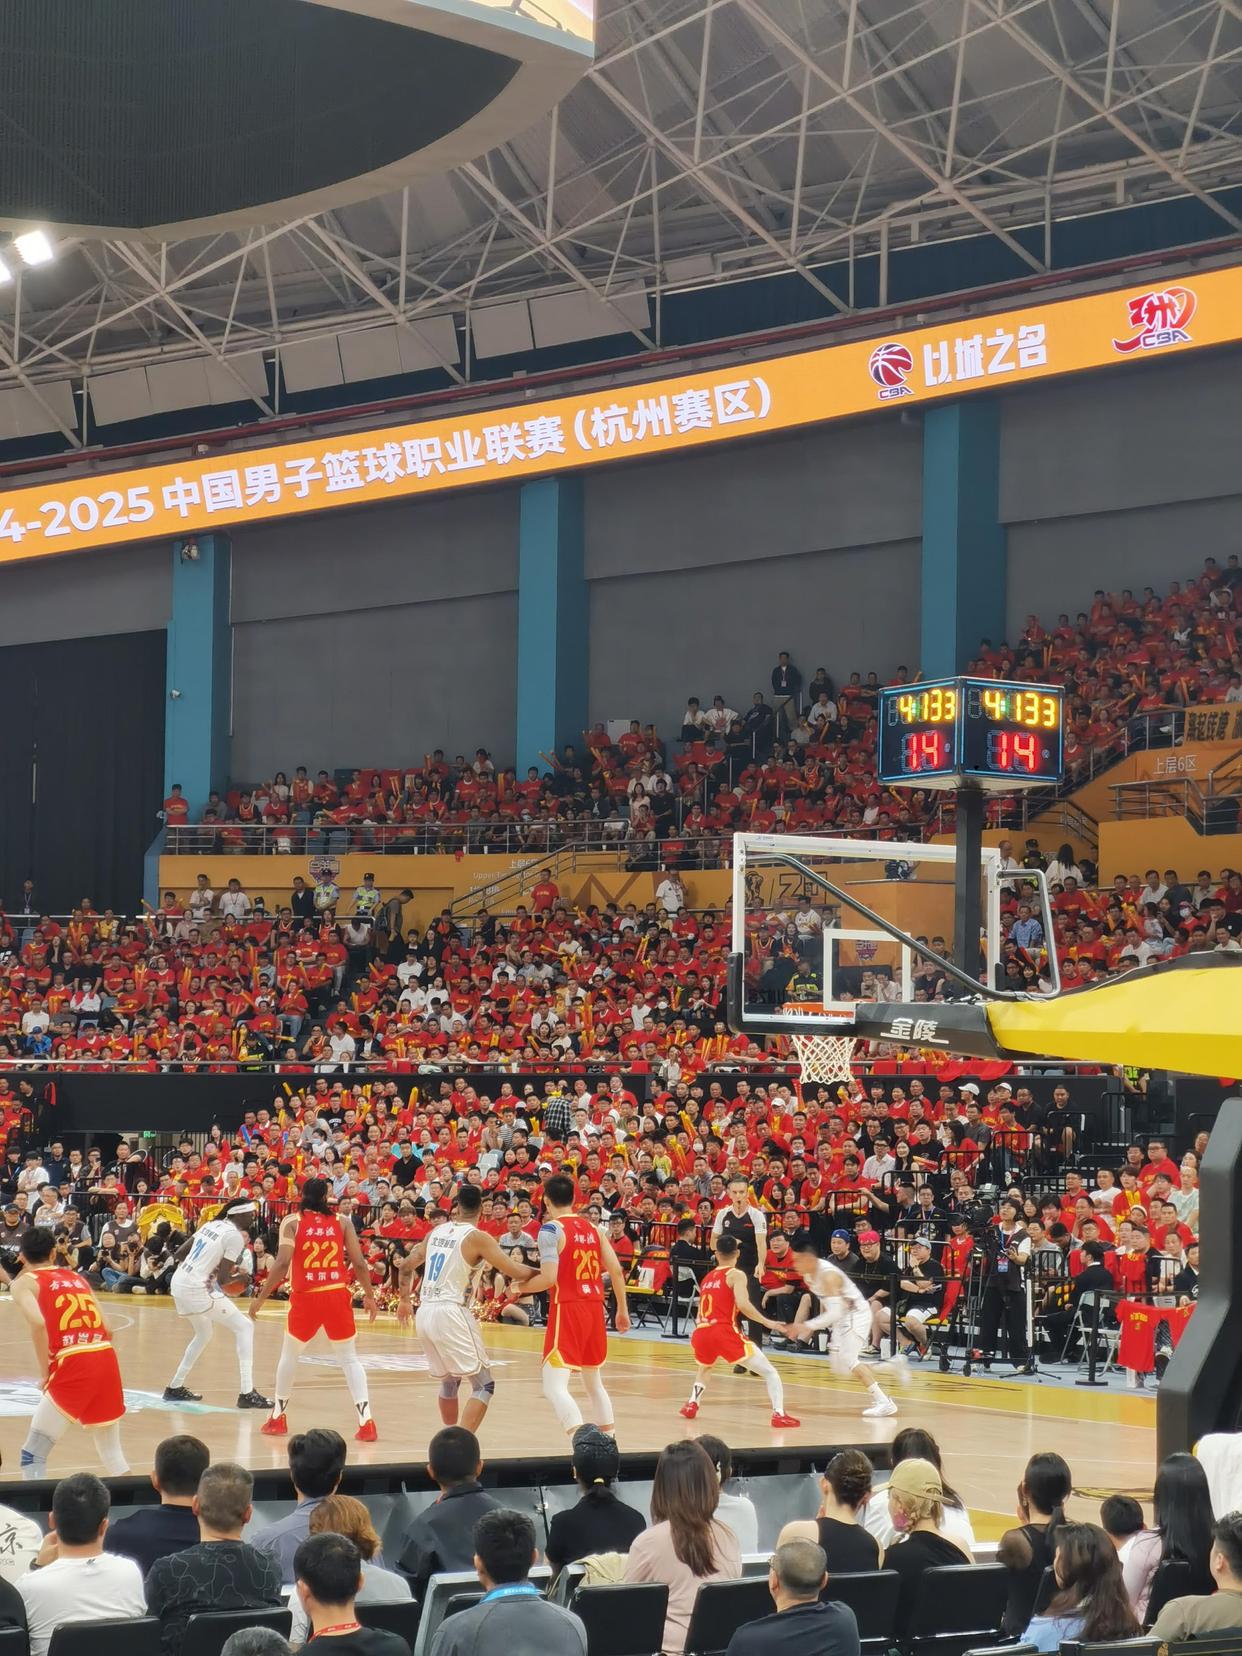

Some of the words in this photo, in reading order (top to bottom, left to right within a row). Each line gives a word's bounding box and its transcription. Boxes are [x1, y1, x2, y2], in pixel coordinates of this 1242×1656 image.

[1142, 330, 1190, 348] CBA
[923, 324, 1048, 387] 以城之名
[879, 387, 915, 399] CBA
[911, 733, 939, 769] 14
[1001, 733, 1036, 770] 14
[1153, 754, 1200, 774] 上层6区
[880, 1017, 949, 1044] 金陵
[302, 1241, 339, 1269] 22
[428, 1252, 446, 1282] 19
[573, 1249, 600, 1281] 26
[55, 1293, 102, 1331] 25
